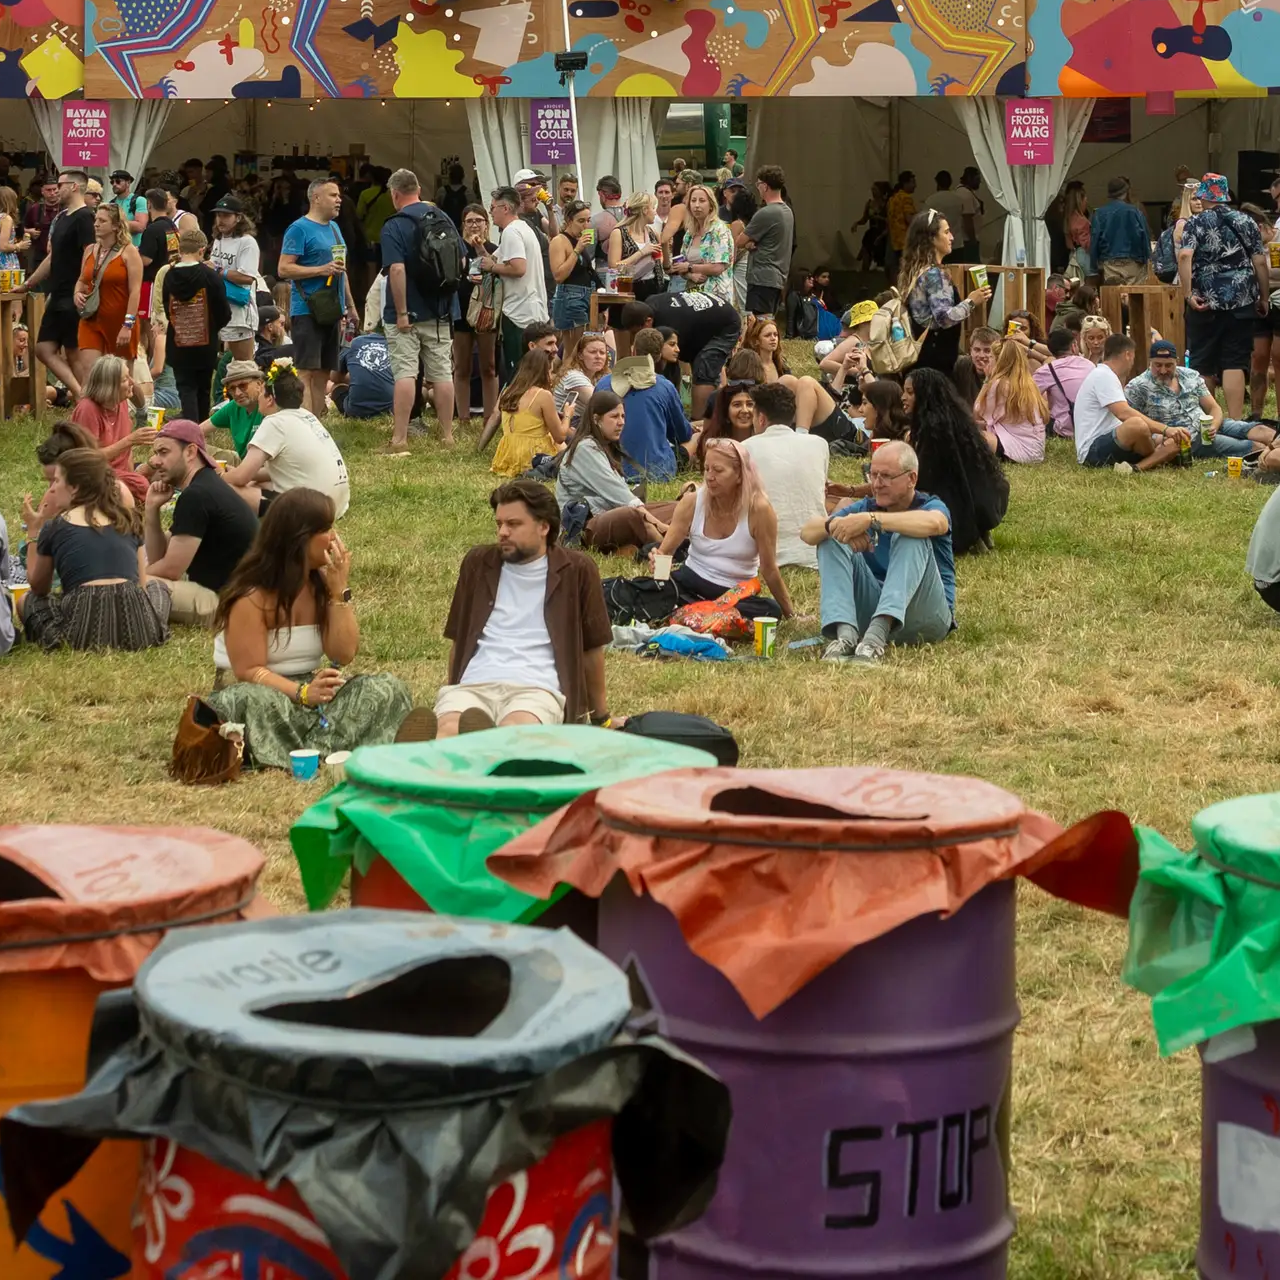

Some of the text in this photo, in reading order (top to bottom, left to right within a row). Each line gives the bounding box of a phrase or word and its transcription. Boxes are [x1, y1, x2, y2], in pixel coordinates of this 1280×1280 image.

[66, 109, 107, 118] HAVANA
[537, 109, 570, 119] PORN
[72, 119, 100, 128] CLUB
[539, 120, 568, 129] STAR
[1011, 116, 1049, 125] FROZEN
[67, 129, 106, 138] MOJITO
[535, 130, 572, 139] COOLER
[1011, 126, 1049, 138] MARG
[822, 1102, 991, 1230] STOP
